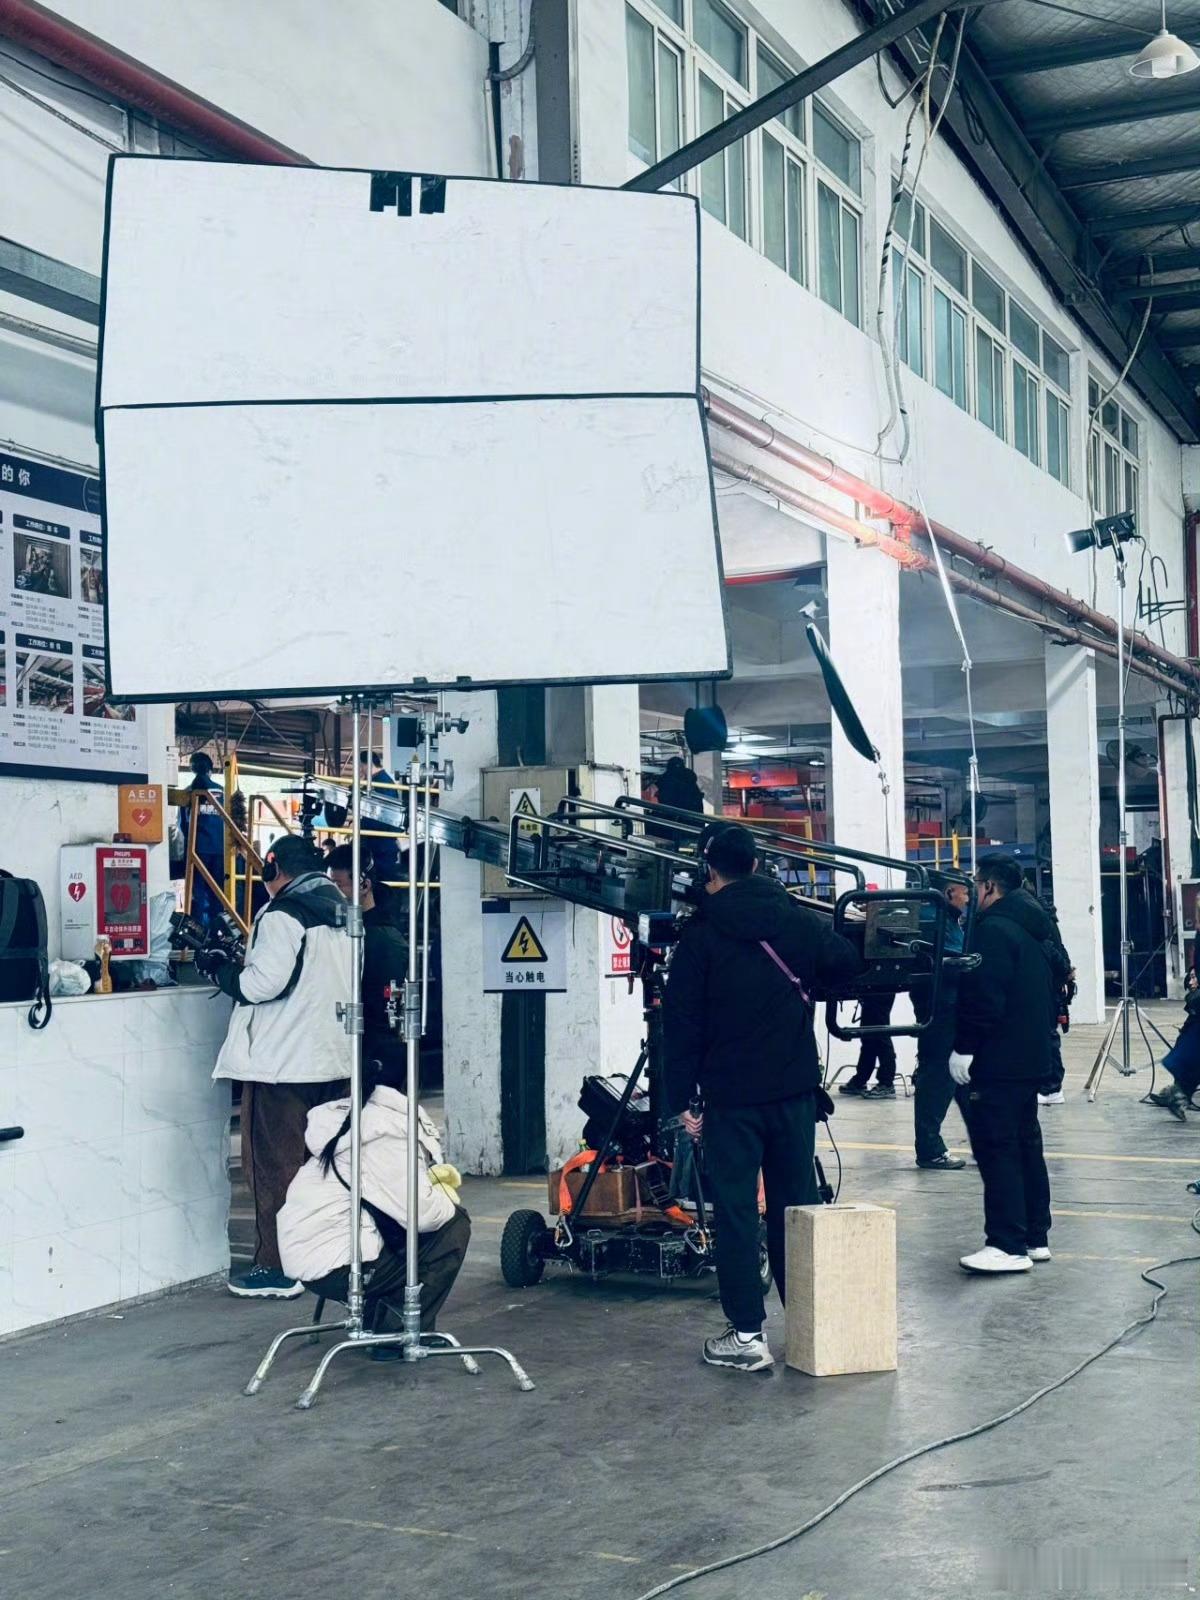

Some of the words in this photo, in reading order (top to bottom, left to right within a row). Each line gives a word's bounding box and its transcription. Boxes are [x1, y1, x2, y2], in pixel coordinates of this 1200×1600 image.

[2, 464, 30, 486] 的你
[128, 789, 156, 799] AED
[506, 971, 545, 983] 当心触电
